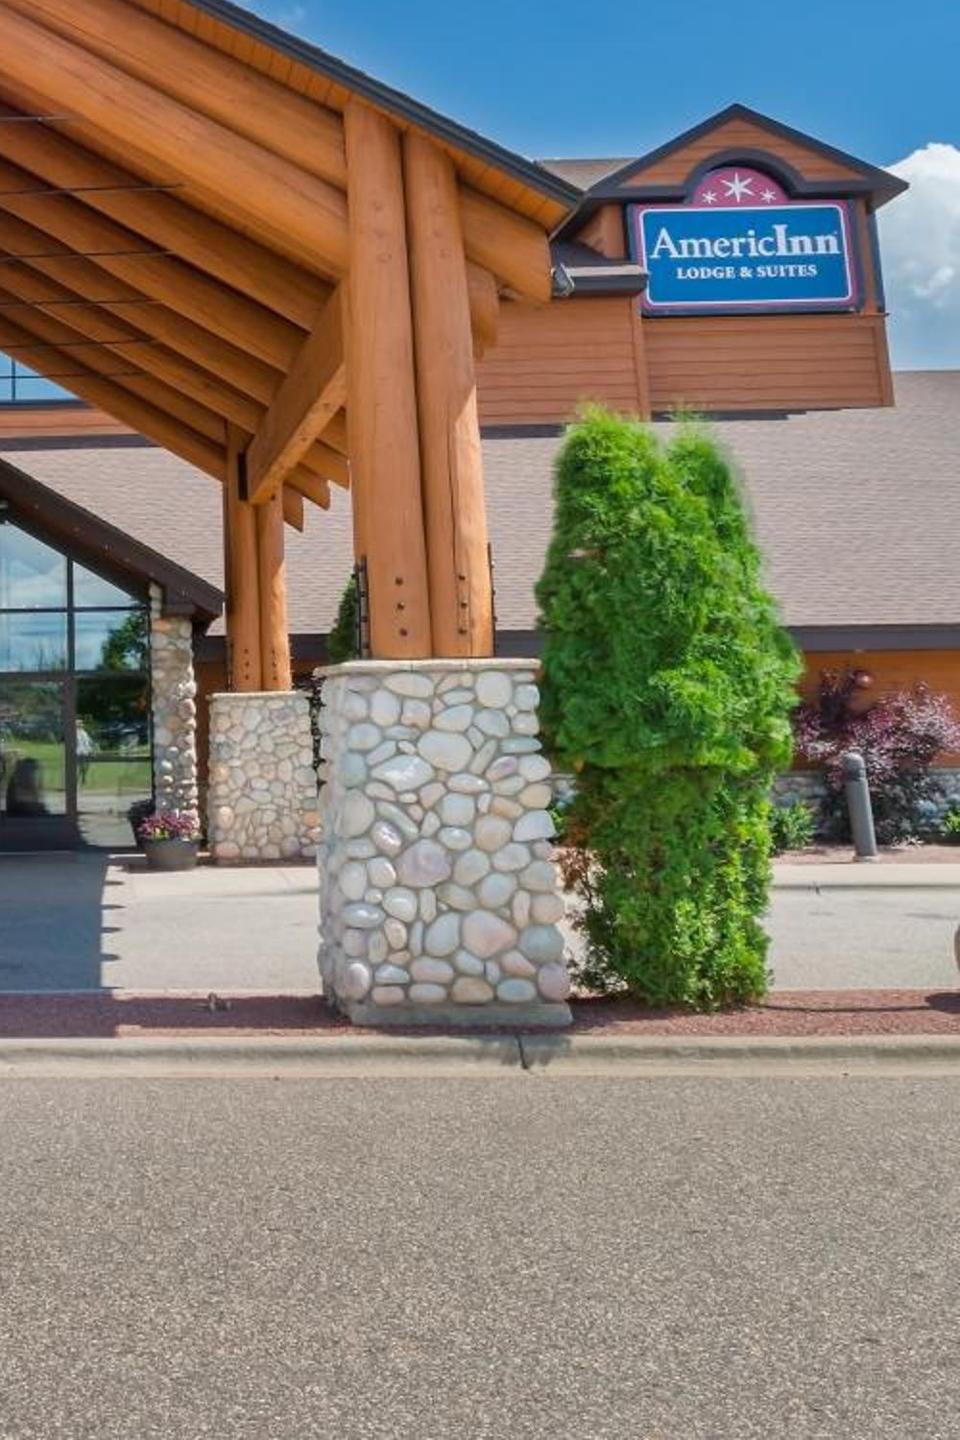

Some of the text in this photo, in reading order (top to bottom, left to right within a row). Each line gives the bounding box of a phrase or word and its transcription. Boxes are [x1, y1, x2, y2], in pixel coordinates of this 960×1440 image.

[649, 224, 840, 259] AmericInn
[677, 264, 817, 279] LODGE & SUITES
